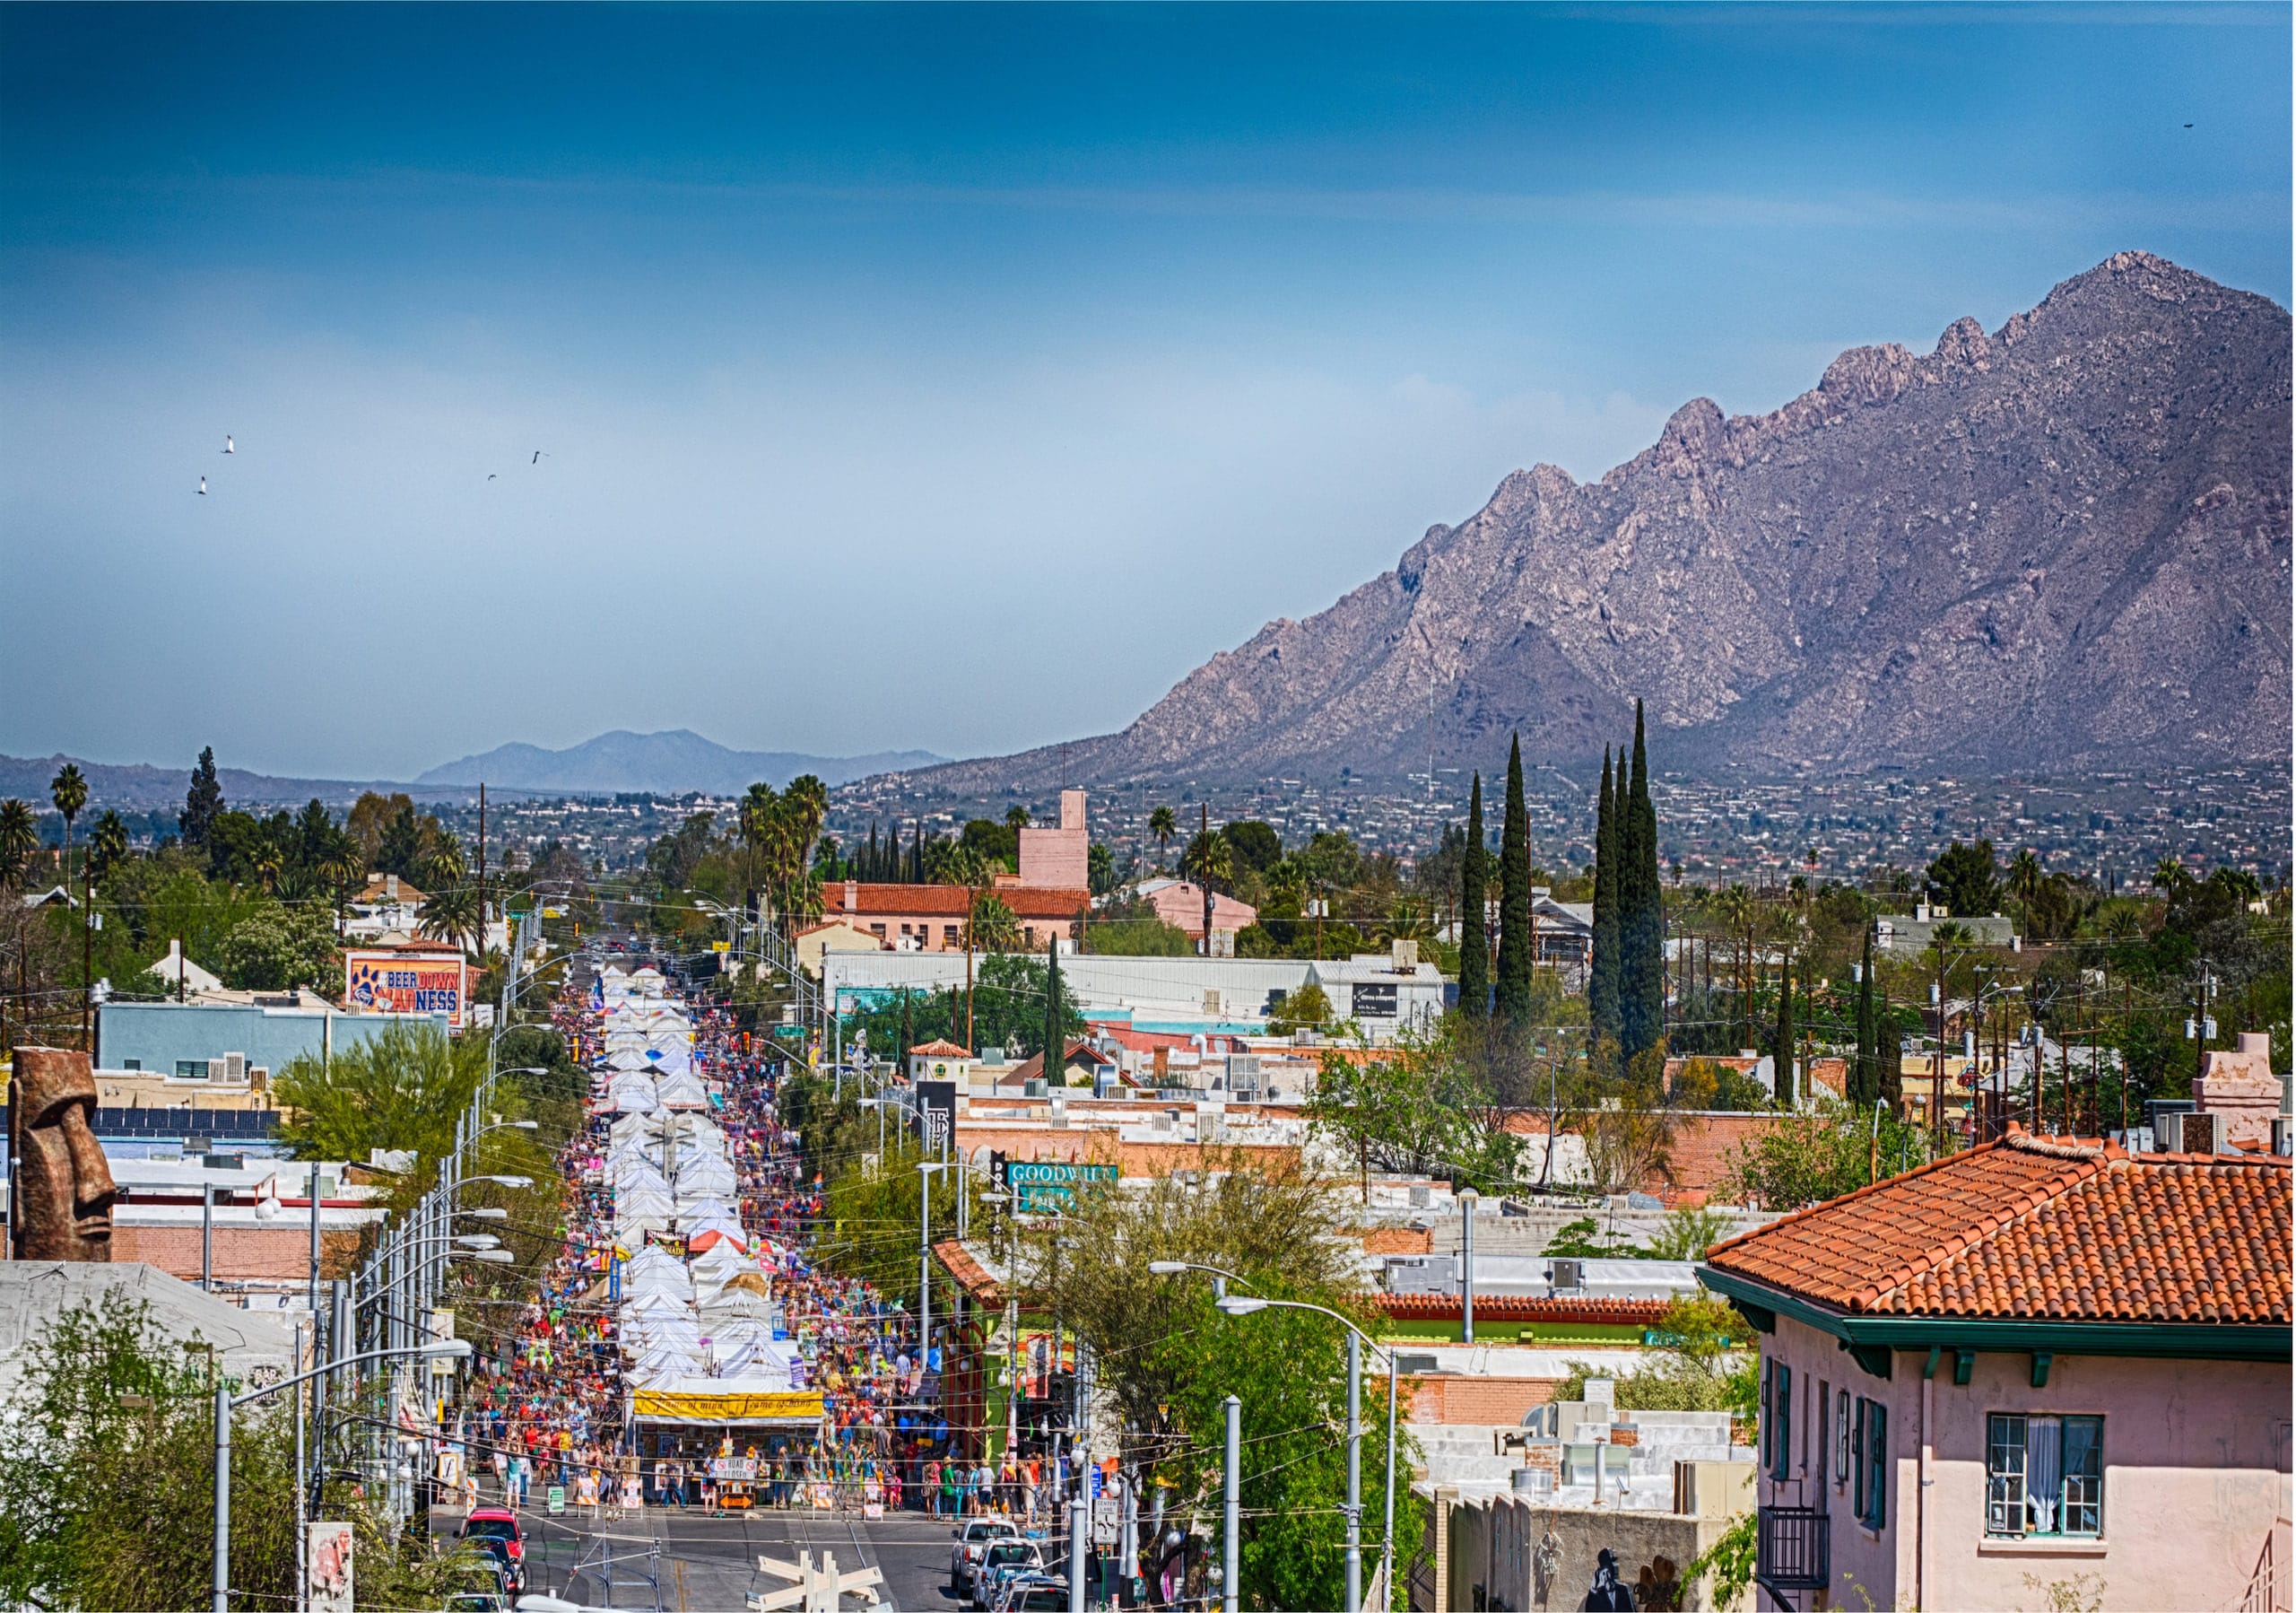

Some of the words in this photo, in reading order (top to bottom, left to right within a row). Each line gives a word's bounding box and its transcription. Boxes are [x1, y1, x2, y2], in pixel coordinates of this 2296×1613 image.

[378, 971, 417, 988] #BEER
[418, 972, 458, 990] DOWN
[378, 989, 457, 1012] MADNESS
[728, 1459, 744, 1469] ROAD
[1097, 1499, 1117, 1507] CENTER
